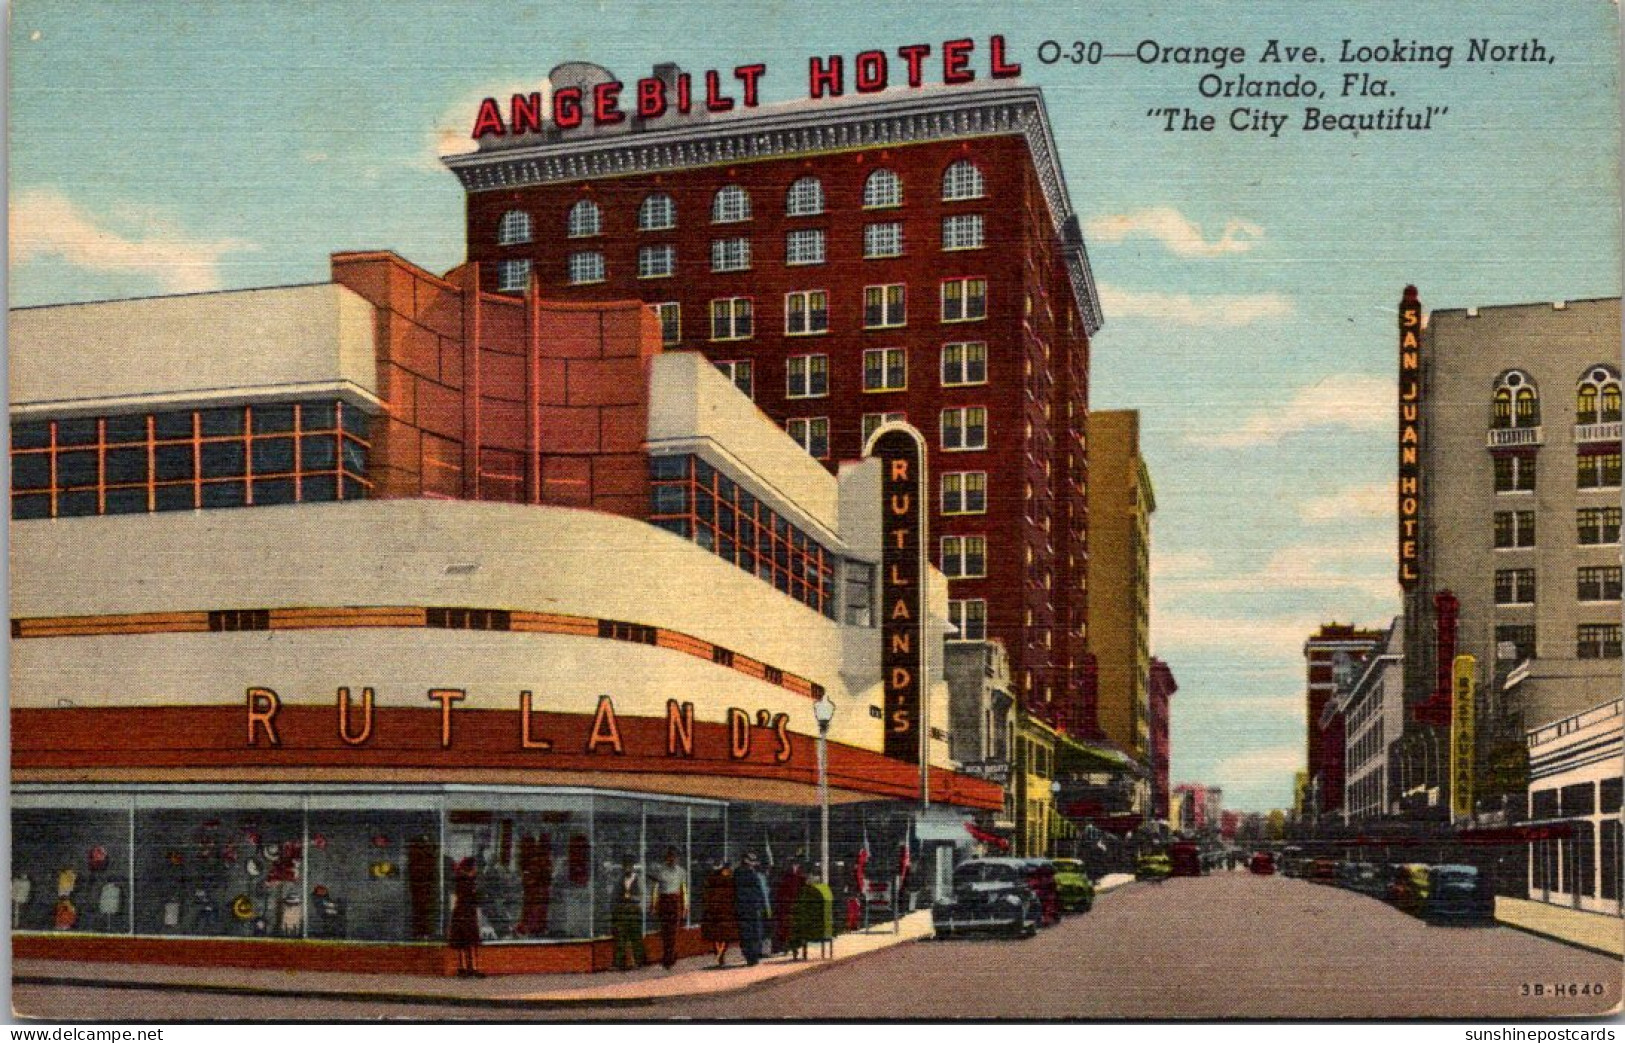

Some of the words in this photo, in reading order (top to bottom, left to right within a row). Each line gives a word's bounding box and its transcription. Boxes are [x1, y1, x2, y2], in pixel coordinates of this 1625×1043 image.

[472, 63, 767, 139] ANGEBILT
[810, 34, 1021, 99] HOTEL
[1403, 309, 1418, 370] SAN
[1403, 382, 1418, 464] JUAN
[1402, 477, 1418, 580] HOTEL
[891, 459, 910, 733] RUTLAND'S
[246, 686, 793, 764] RUTLAND'S
